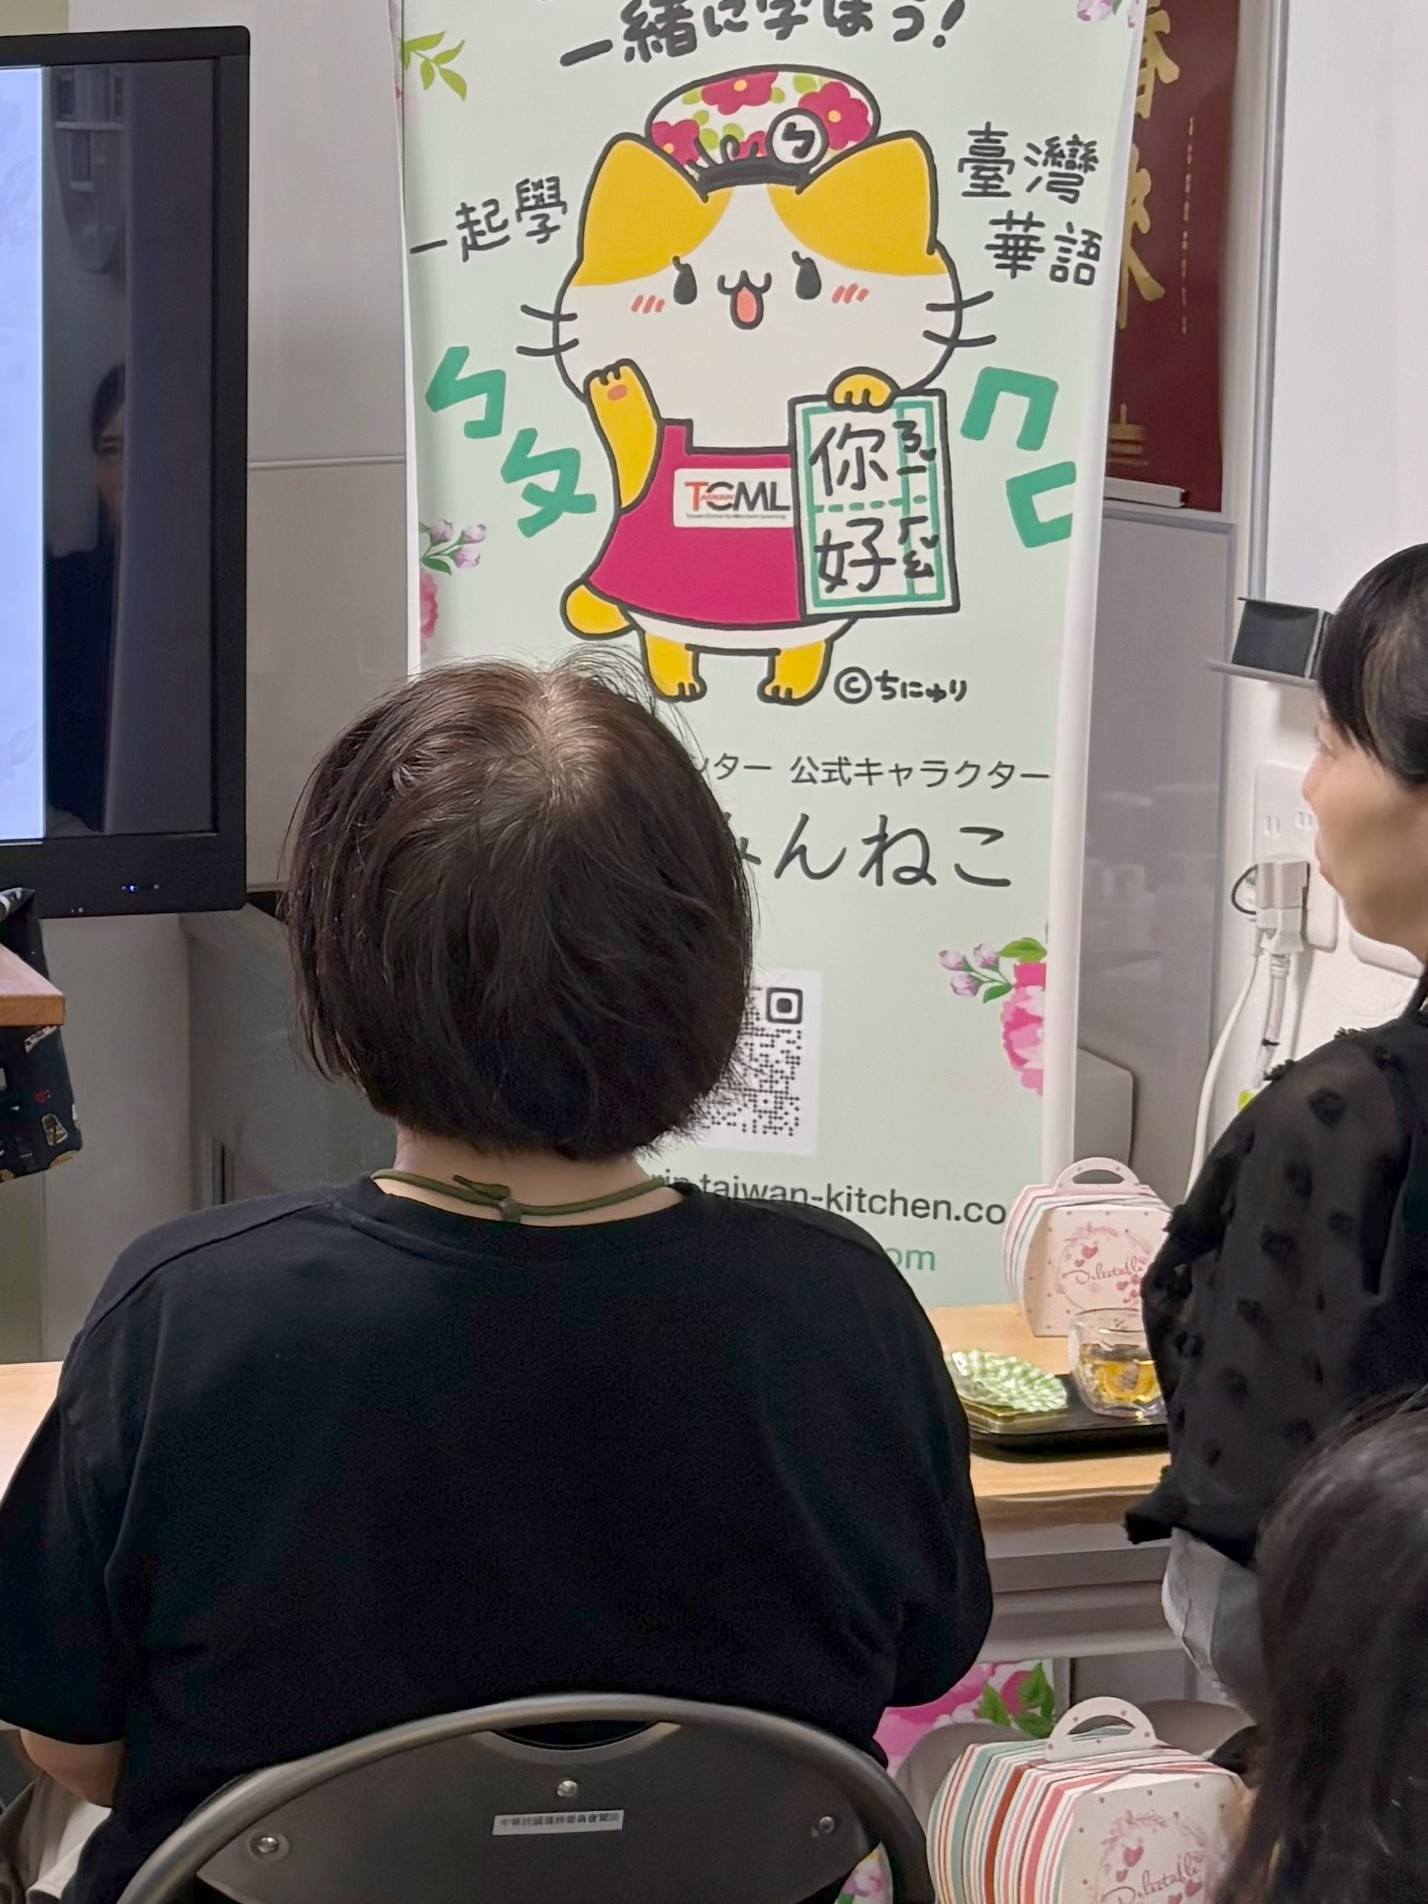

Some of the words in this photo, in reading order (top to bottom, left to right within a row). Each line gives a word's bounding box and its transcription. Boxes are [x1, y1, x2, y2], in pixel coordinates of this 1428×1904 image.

[957, 121, 1100, 205] 臺灣
[409, 175, 568, 263] 一起學
[984, 209, 1104, 287] 華語
[684, 480, 791, 513] TCML
[808, 422, 898, 594] 你好
[789, 755, 1052, 790] 公式キャラクター
